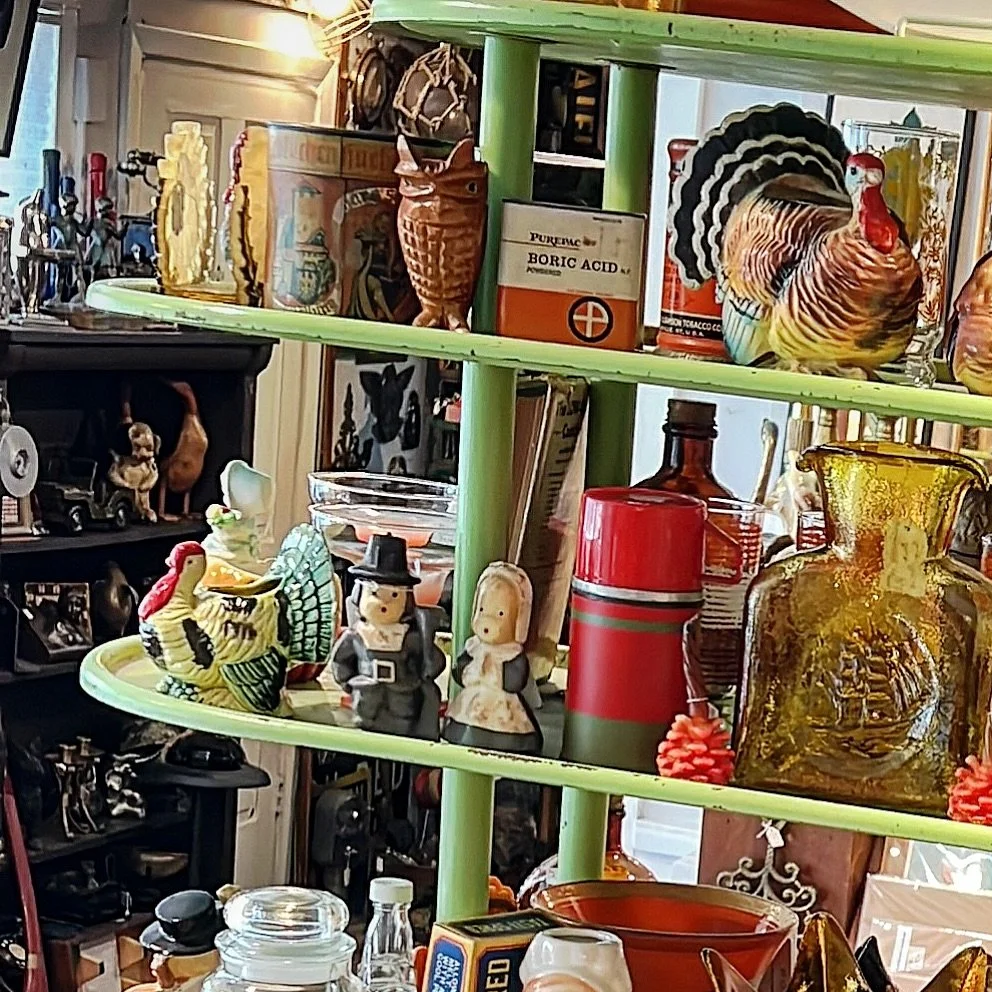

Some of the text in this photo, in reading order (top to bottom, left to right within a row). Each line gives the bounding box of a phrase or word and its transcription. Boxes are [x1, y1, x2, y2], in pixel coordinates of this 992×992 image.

[529, 231, 581, 248] PUREPAC
[528, 252, 577, 269] BORIC
[581, 259, 618, 274] ACID
[683, 320, 711, 331] TOBACCO
[435, 952, 445, 983] COOL
[439, 956, 449, 983] WITH
